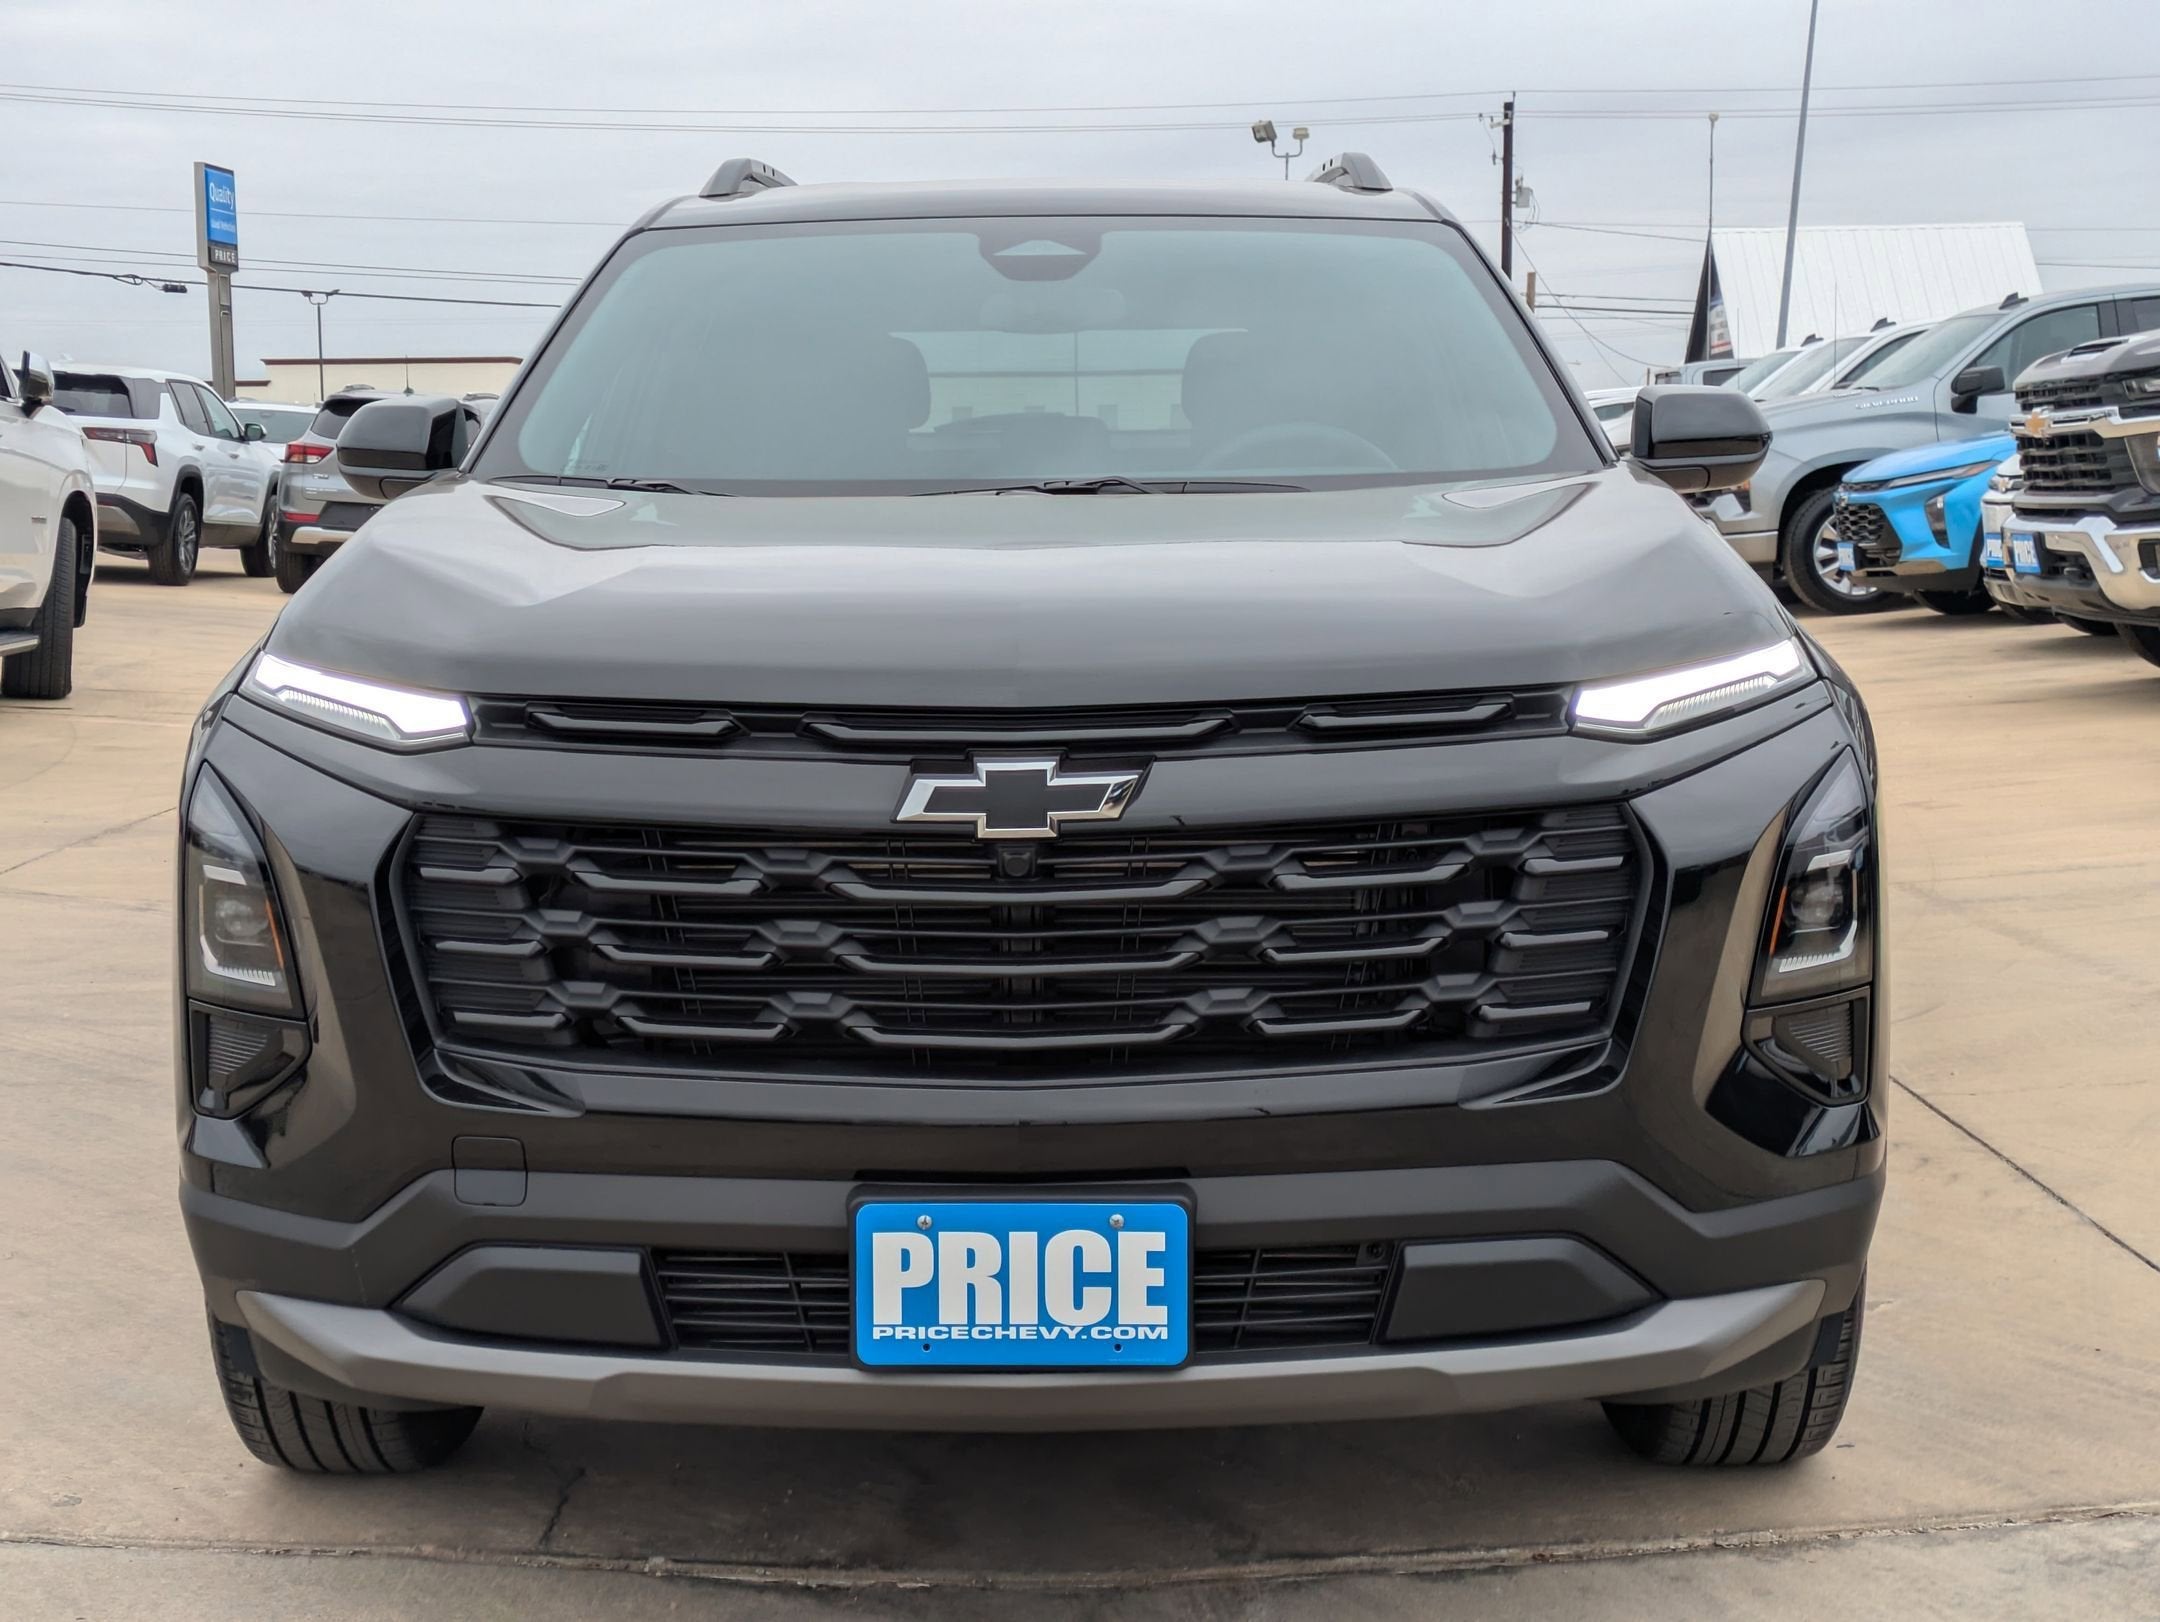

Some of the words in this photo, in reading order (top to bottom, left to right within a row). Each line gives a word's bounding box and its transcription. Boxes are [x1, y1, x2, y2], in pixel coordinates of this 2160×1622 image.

[209, 182, 235, 210] Quality
[214, 249, 236, 264] PRICE
[872, 1229, 1168, 1326] PRICE
[872, 1326, 1168, 1340] PRICECHEVY.COM
